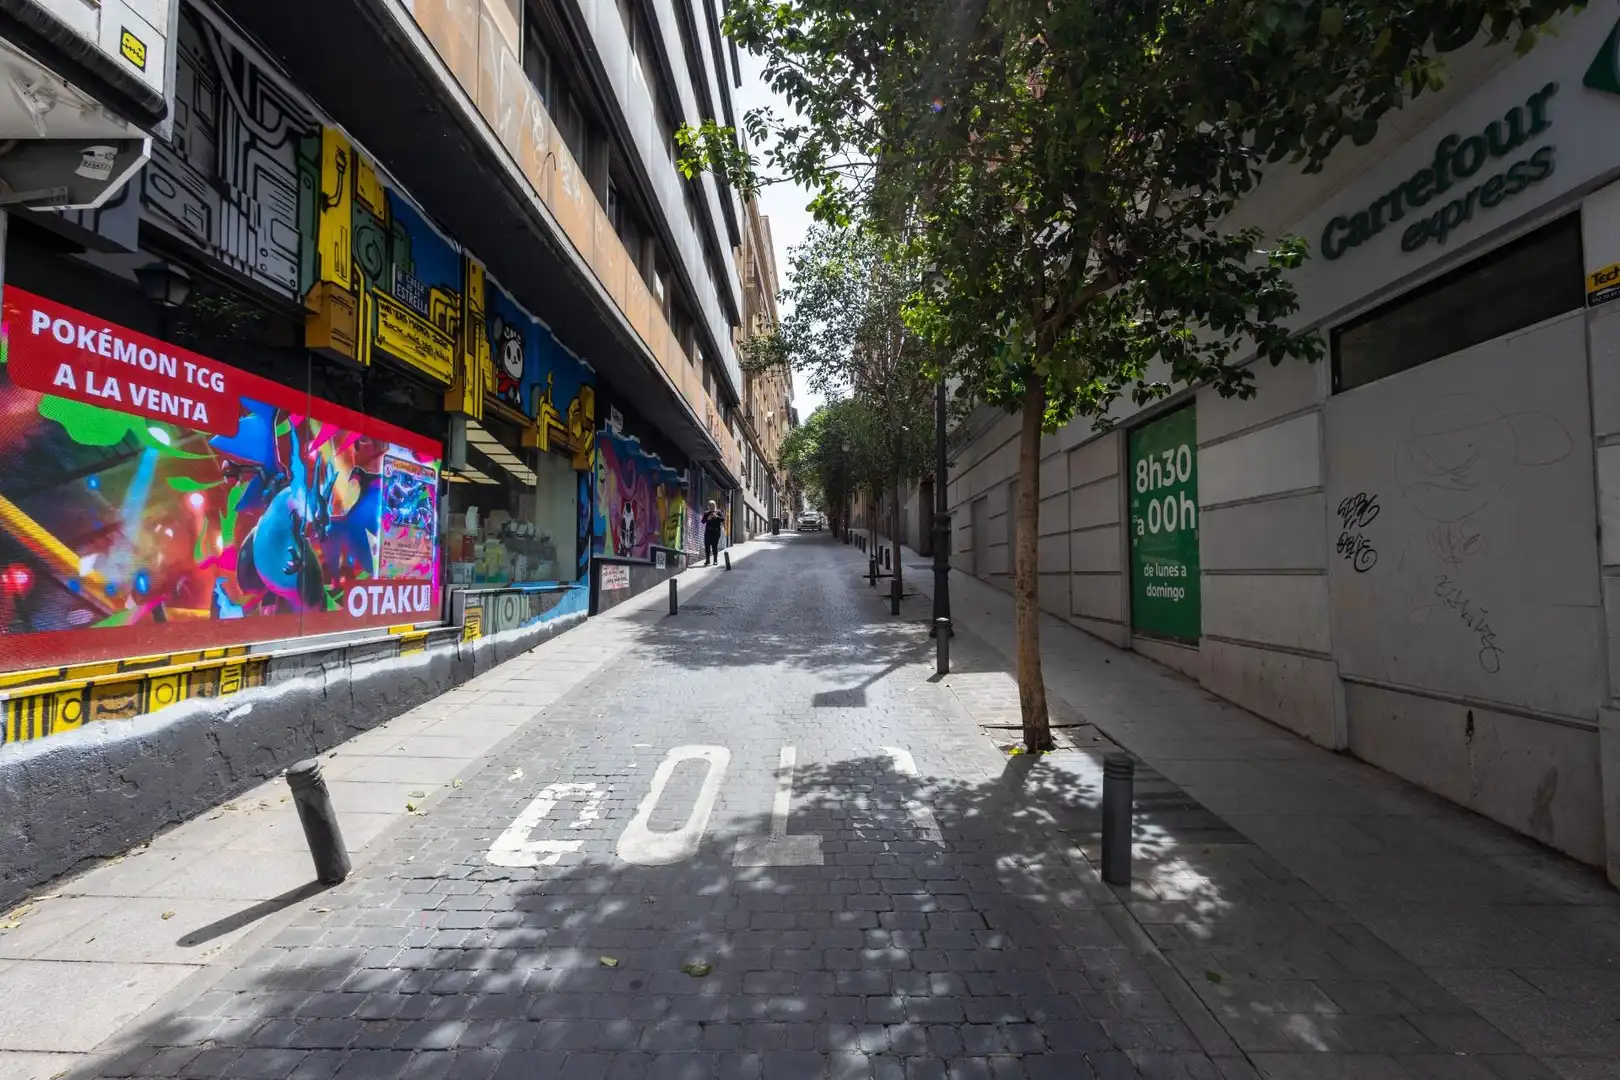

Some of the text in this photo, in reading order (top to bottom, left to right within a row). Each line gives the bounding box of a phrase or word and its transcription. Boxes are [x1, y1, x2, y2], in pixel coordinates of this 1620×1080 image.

[1320, 82, 1559, 261] Carrefour
[1400, 145, 1557, 254] express
[396, 284, 428, 315] ESTRELLA
[405, 273, 425, 294] CALLE
[30, 309, 226, 394] POKÉMON TCG
[53, 363, 209, 424] A LA VENTA
[1135, 444, 1192, 495] 8h30
[1136, 490, 1196, 536] a 00h
[1143, 562, 1187, 577] de lunes a
[1146, 582, 1185, 602] domingo
[347, 585, 425, 618] OTAKU
